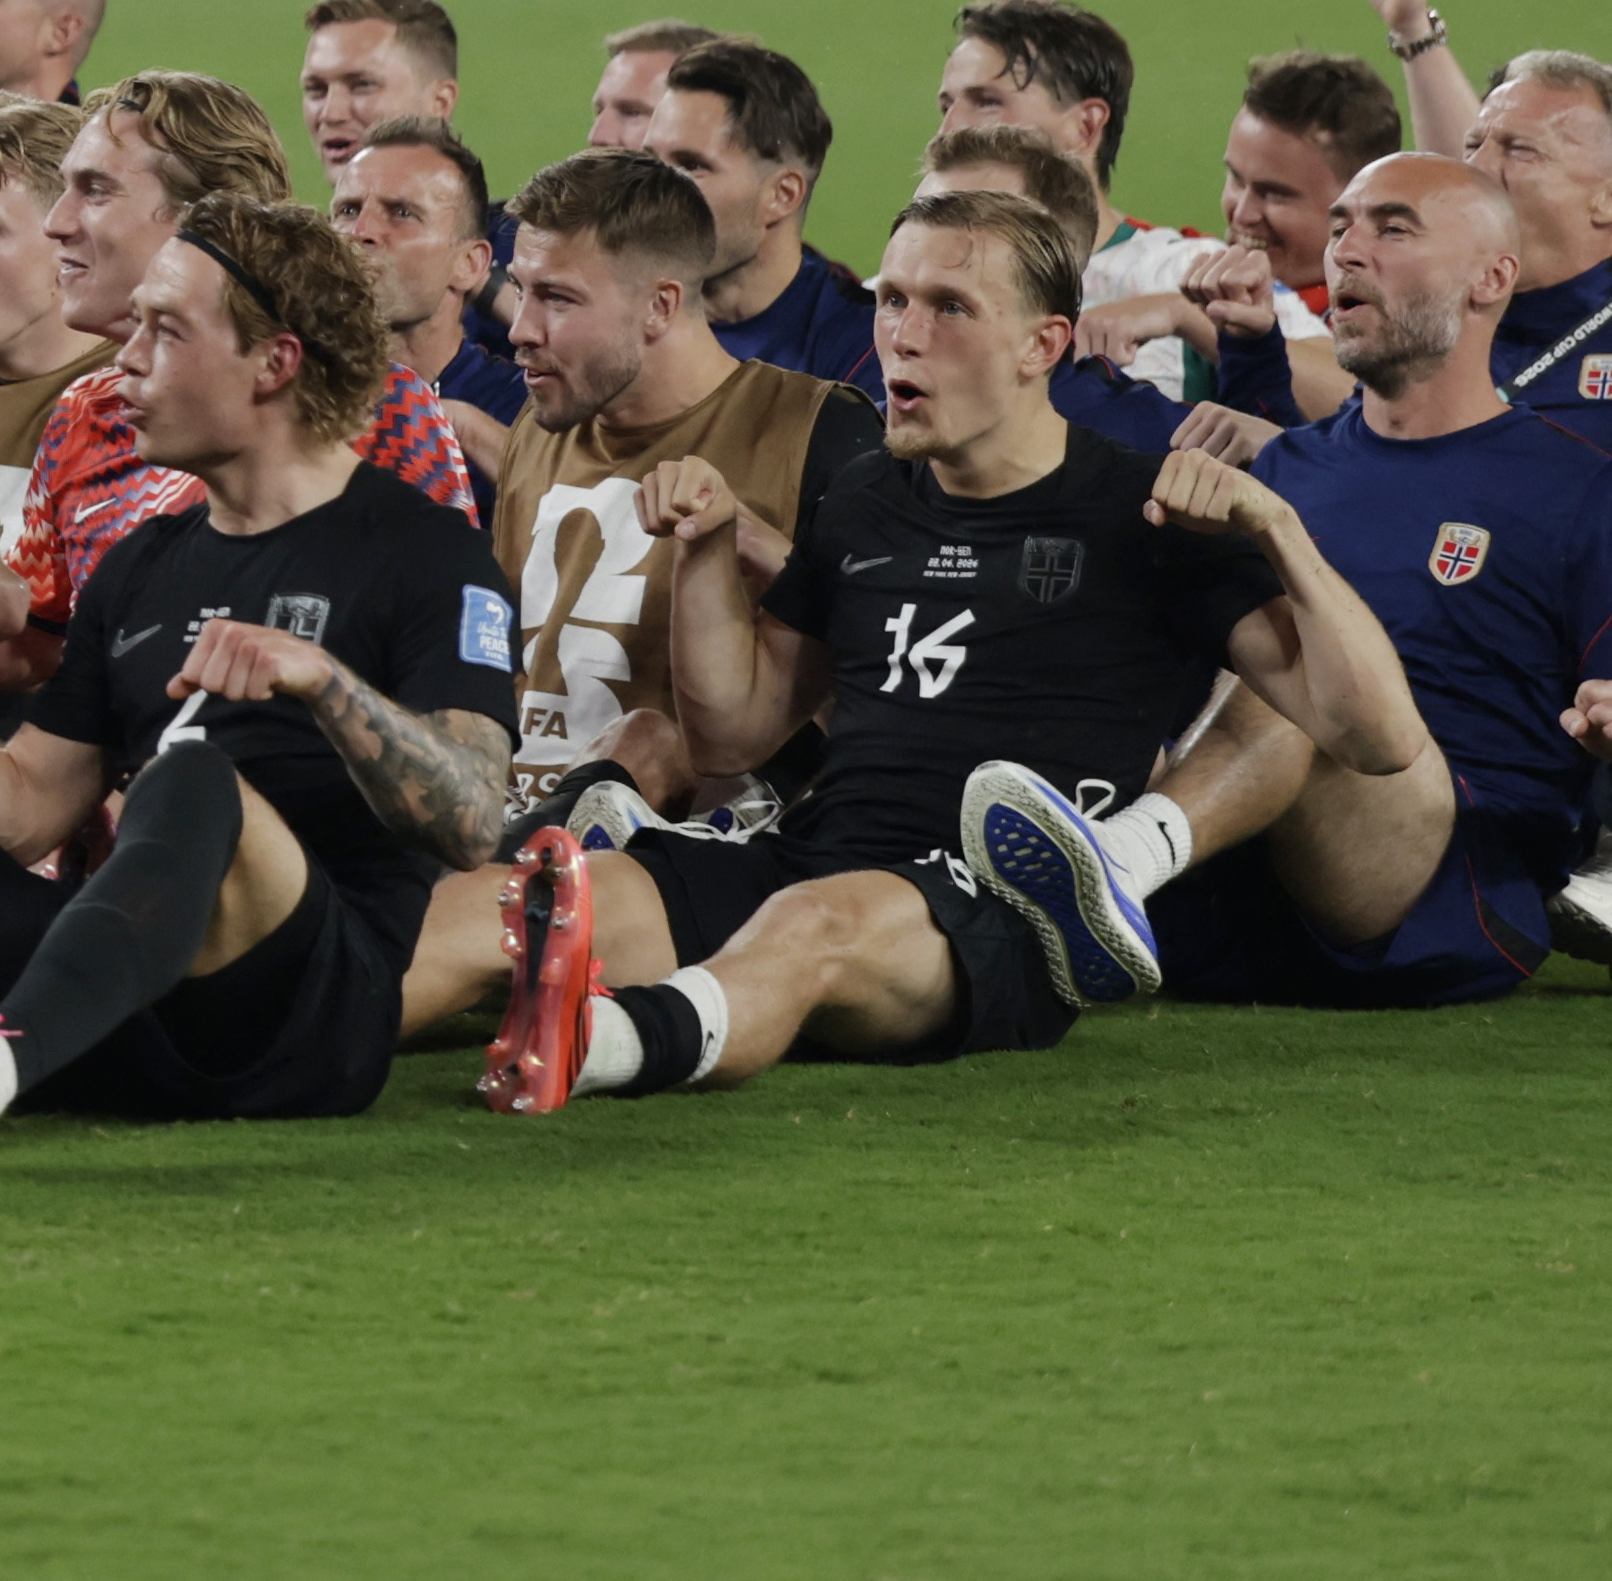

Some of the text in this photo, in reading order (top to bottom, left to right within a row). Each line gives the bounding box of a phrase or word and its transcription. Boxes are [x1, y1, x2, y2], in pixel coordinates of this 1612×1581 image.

[1554, 336, 1576, 358] CUP
[1513, 352, 1554, 387] 2026
[878, 603, 976, 699] 16
